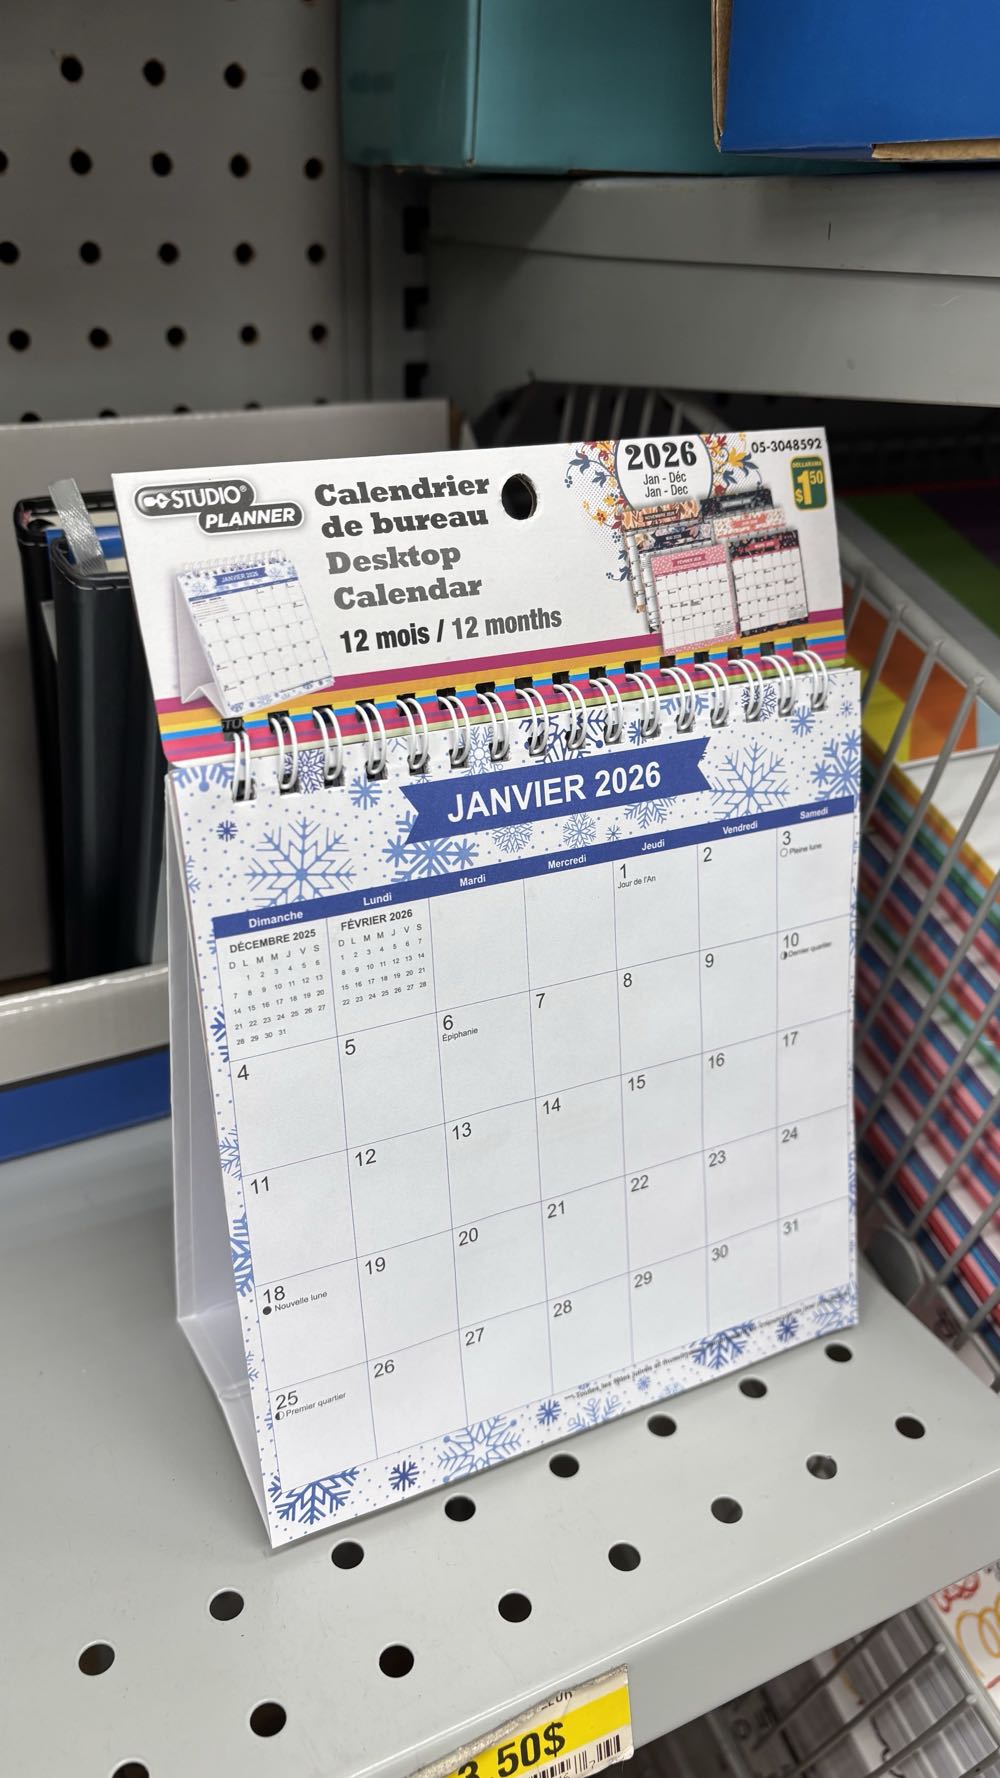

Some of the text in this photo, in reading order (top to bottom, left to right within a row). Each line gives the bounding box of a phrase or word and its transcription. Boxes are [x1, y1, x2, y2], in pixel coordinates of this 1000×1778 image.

[751, 438, 822, 453] 05-3048592
[625, 441, 697, 470] 2026
[643, 474, 660, 485] Jan
[669, 471, 687, 483] Déc
[315, 475, 490, 506] Calendrier
[645, 486, 662, 498] Jan
[670, 484, 688, 496] Dec
[204, 507, 296, 529] PLANNER
[321, 509, 489, 538] de bureau
[325, 545, 461, 575] Desktop
[334, 577, 482, 610] Calendar
[340, 608, 562, 653] 12 mois / 12 months
[448, 761, 661, 822] JANVIER 2026
[782, 830, 791, 846] 3
[703, 847, 712, 862] 2
[249, 807, 828, 928] Dimanche Lundi Mardi Mercredi Jeudi Vendredi Samedi
[620, 864, 626, 879] 1
[617, 881, 632, 889] Jour
[341, 909, 413, 931] FÉVRIER 2026
[229, 929, 316, 953] DÉCEMBRE 2025
[338, 939, 345, 947] D
[363, 934, 370, 942] M
[377, 931, 384, 939] M
[416, 923, 422, 931] S
[784, 932, 799, 948] 10
[229, 962, 236, 970] D
[256, 956, 264, 964] M
[286, 950, 291, 958] J
[299, 947, 306, 955] V
[313, 944, 320, 952] S
[705, 953, 714, 968] 9
[623, 973, 632, 988] 8
[536, 993, 545, 1008] 7
[443, 1015, 453, 1030] 6
[442, 1027, 478, 1042] Épiphanie
[783, 1031, 798, 1047] 17
[345, 1038, 356, 1055] 5
[709, 1053, 725, 1069] 16
[237, 1064, 249, 1080] 4
[628, 1074, 646, 1091] 15
[543, 1097, 561, 1114] 14
[452, 1122, 472, 1140] 13
[782, 1127, 798, 1143] 24
[355, 1149, 376, 1166] 12
[709, 1150, 726, 1167] 23
[251, 1176, 269, 1194] 11
[631, 1175, 649, 1192] 22
[547, 1201, 564, 1219] 21
[784, 1219, 798, 1235] 31
[459, 1227, 478, 1246] 20
[712, 1244, 729, 1261] 30
[365, 1257, 385, 1275] 19
[634, 1271, 652, 1288] 29
[263, 1286, 285, 1304] 18
[274, 1292, 327, 1311] Nouvelle lune
[553, 1300, 572, 1318] 28
[465, 1327, 484, 1346] 27
[374, 1359, 395, 1378] 26
[276, 1390, 298, 1410] 25
[286, 1393, 346, 1417] Premier quartier
